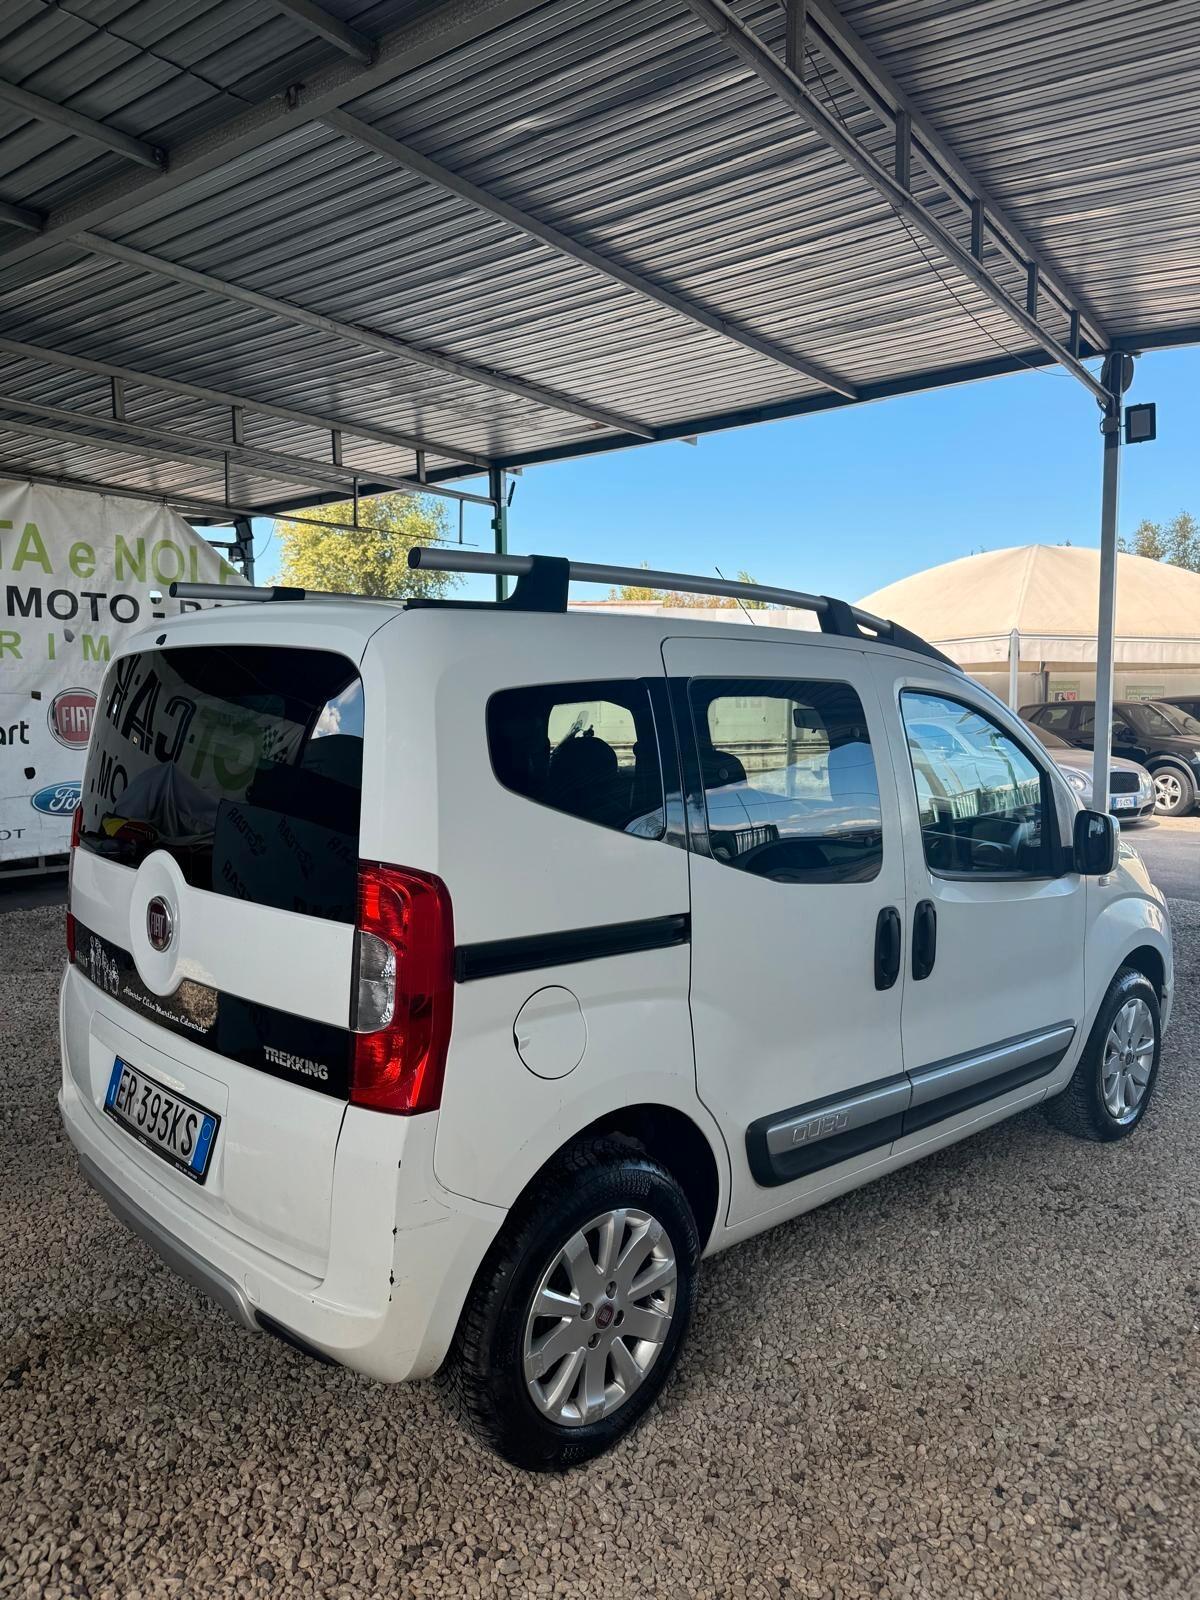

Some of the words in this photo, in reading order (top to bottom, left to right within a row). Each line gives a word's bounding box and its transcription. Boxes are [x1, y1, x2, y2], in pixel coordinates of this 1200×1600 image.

[69, 540, 96, 578] e
[6, 585, 140, 624] MOTO
[61, 706, 95, 734] FIAT
[151, 911, 165, 938] FIAT
[263, 1045, 329, 1081] TREKKING
